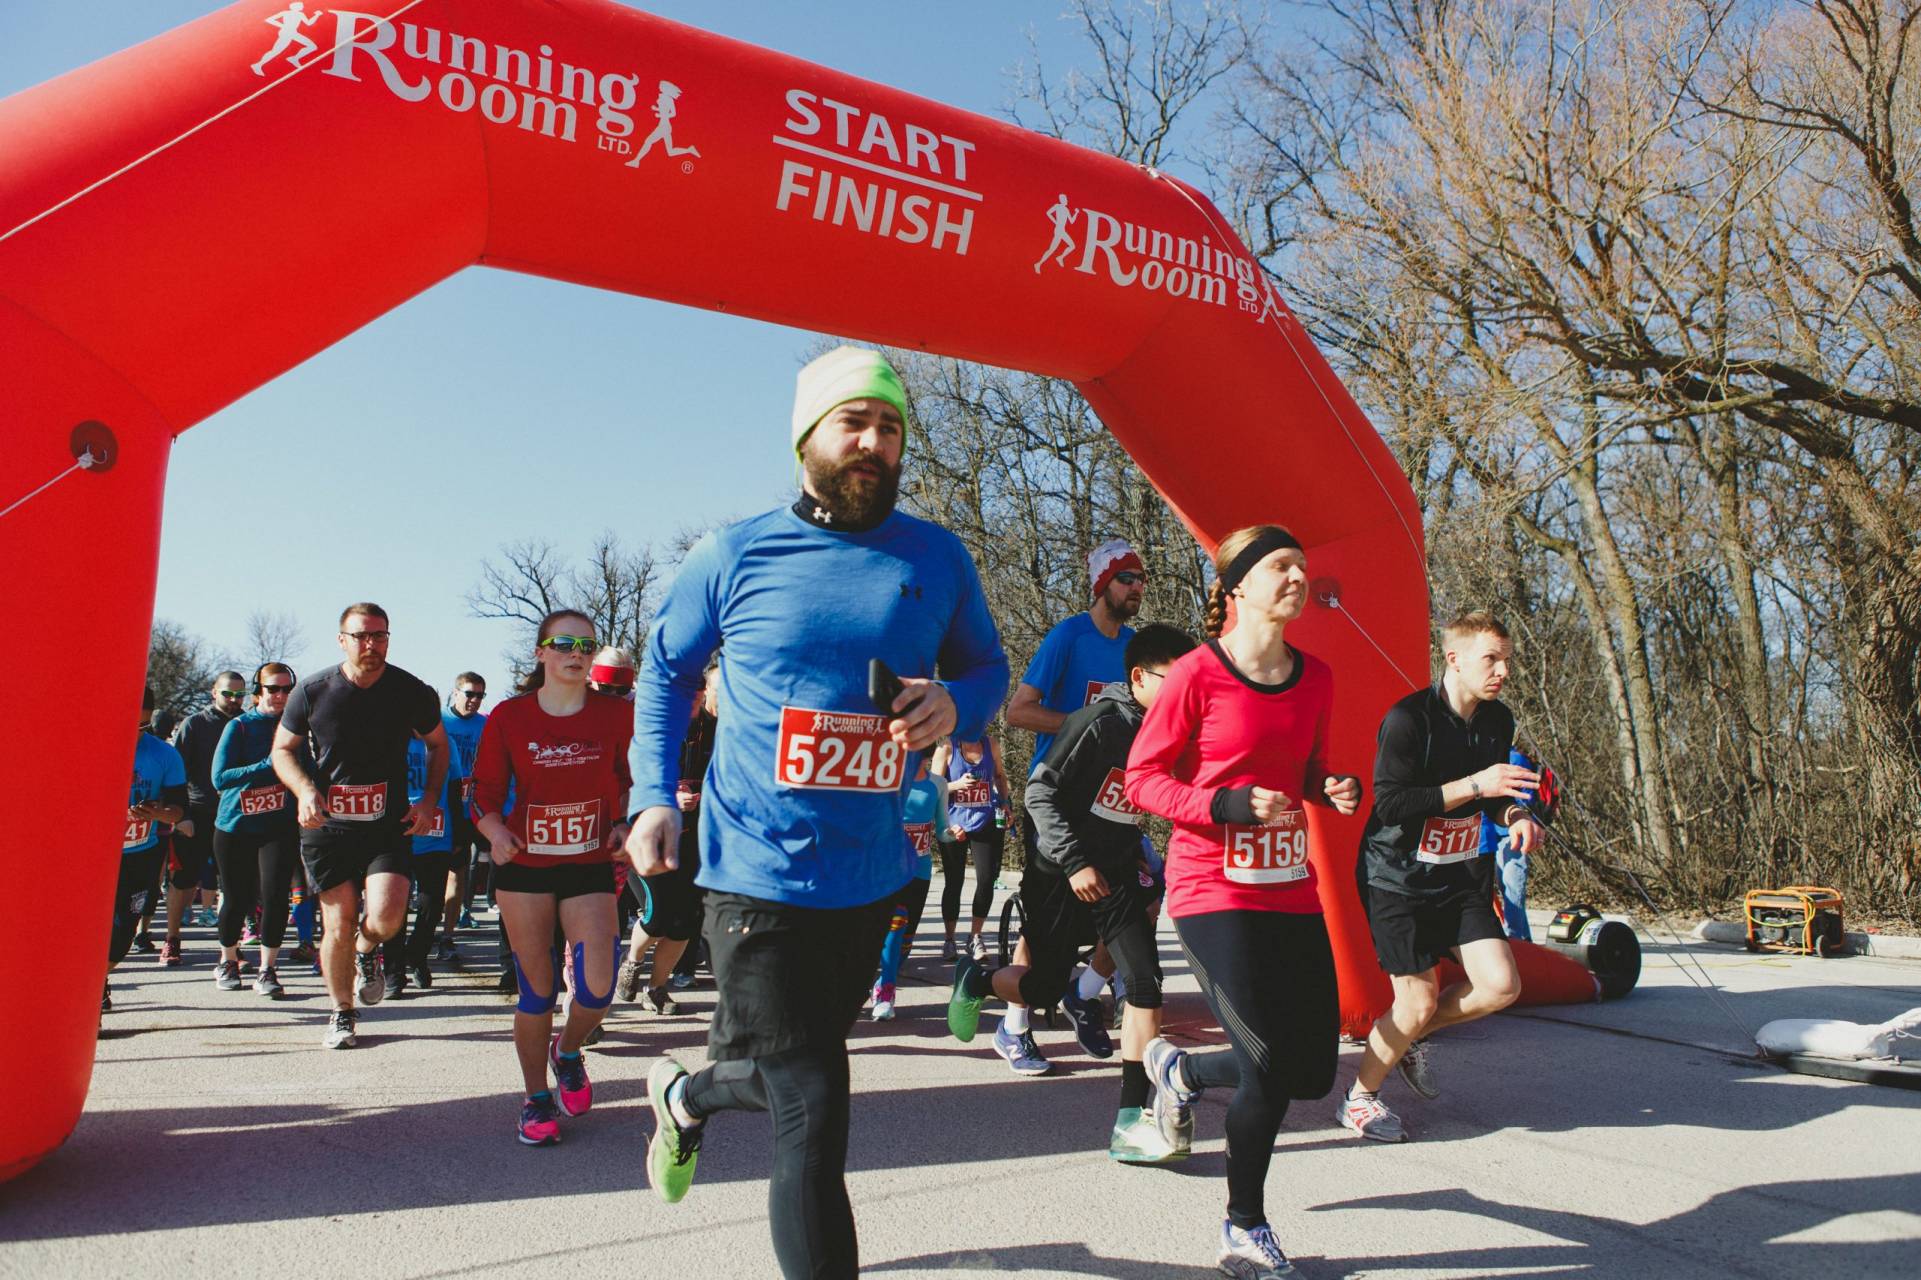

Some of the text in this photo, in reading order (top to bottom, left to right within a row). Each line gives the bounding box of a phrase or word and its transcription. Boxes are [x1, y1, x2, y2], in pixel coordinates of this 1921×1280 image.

[321, 9, 640, 137] Running
[598, 135, 632, 155] LTD.
[785, 89, 976, 181] START
[775, 159, 974, 255] FINISH
[1074, 207, 1258, 302] Running
[823, 714, 875, 735] Running
[785, 733, 899, 787] 5248
[245, 791, 285, 814] 5237
[332, 793, 383, 814] 5118
[957, 788, 987, 802] 5176
[532, 814, 595, 844] 5157
[1426, 825, 1480, 854] 5117
[1233, 829, 1306, 868] 5159
